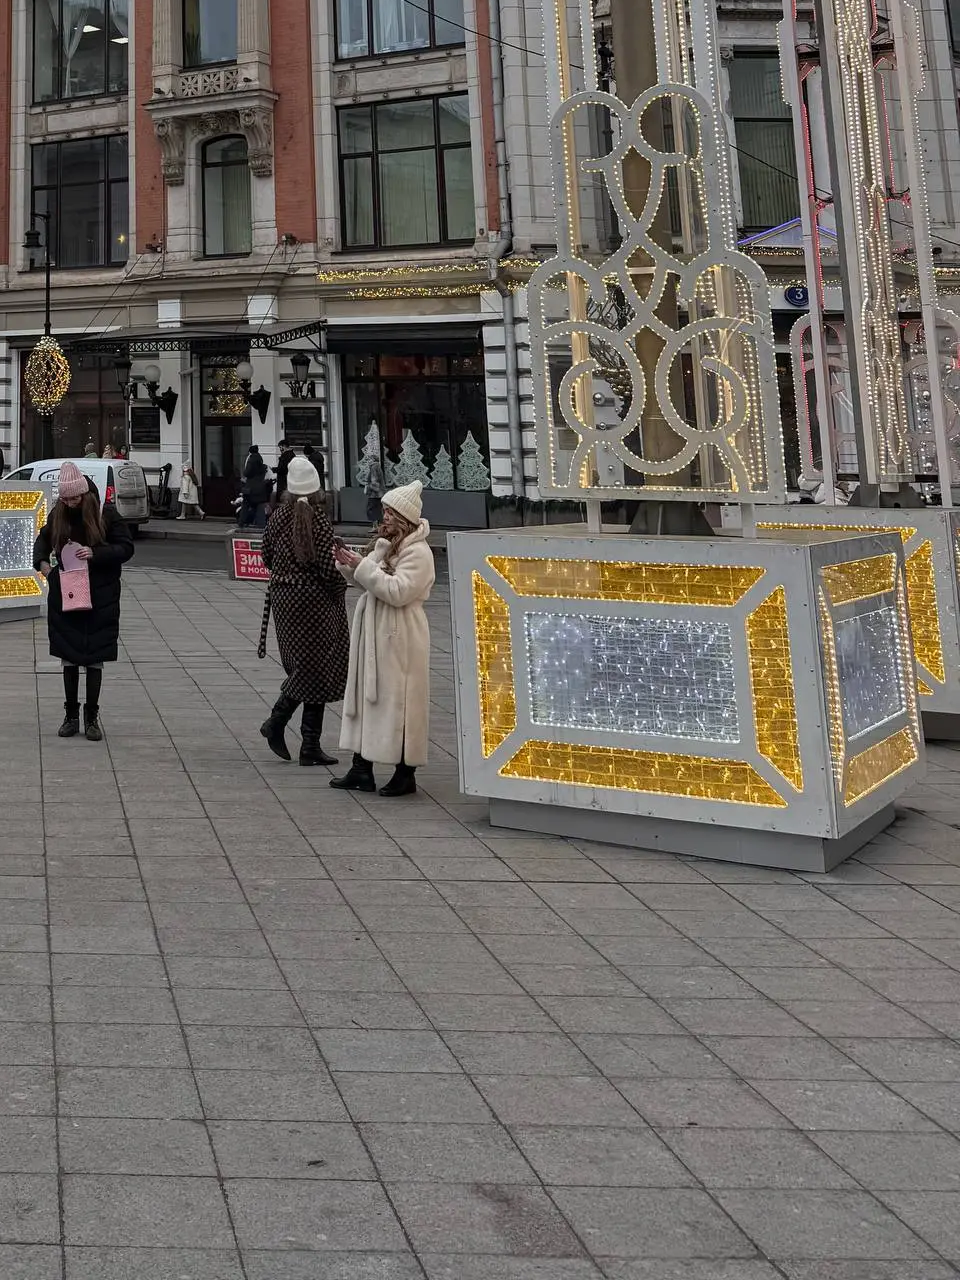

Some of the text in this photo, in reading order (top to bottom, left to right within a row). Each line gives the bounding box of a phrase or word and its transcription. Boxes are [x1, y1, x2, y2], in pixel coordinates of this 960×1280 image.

[795, 288, 803, 300] 3
[240, 553, 264, 567] ЗИМ
[248, 567, 272, 575] МОСК
